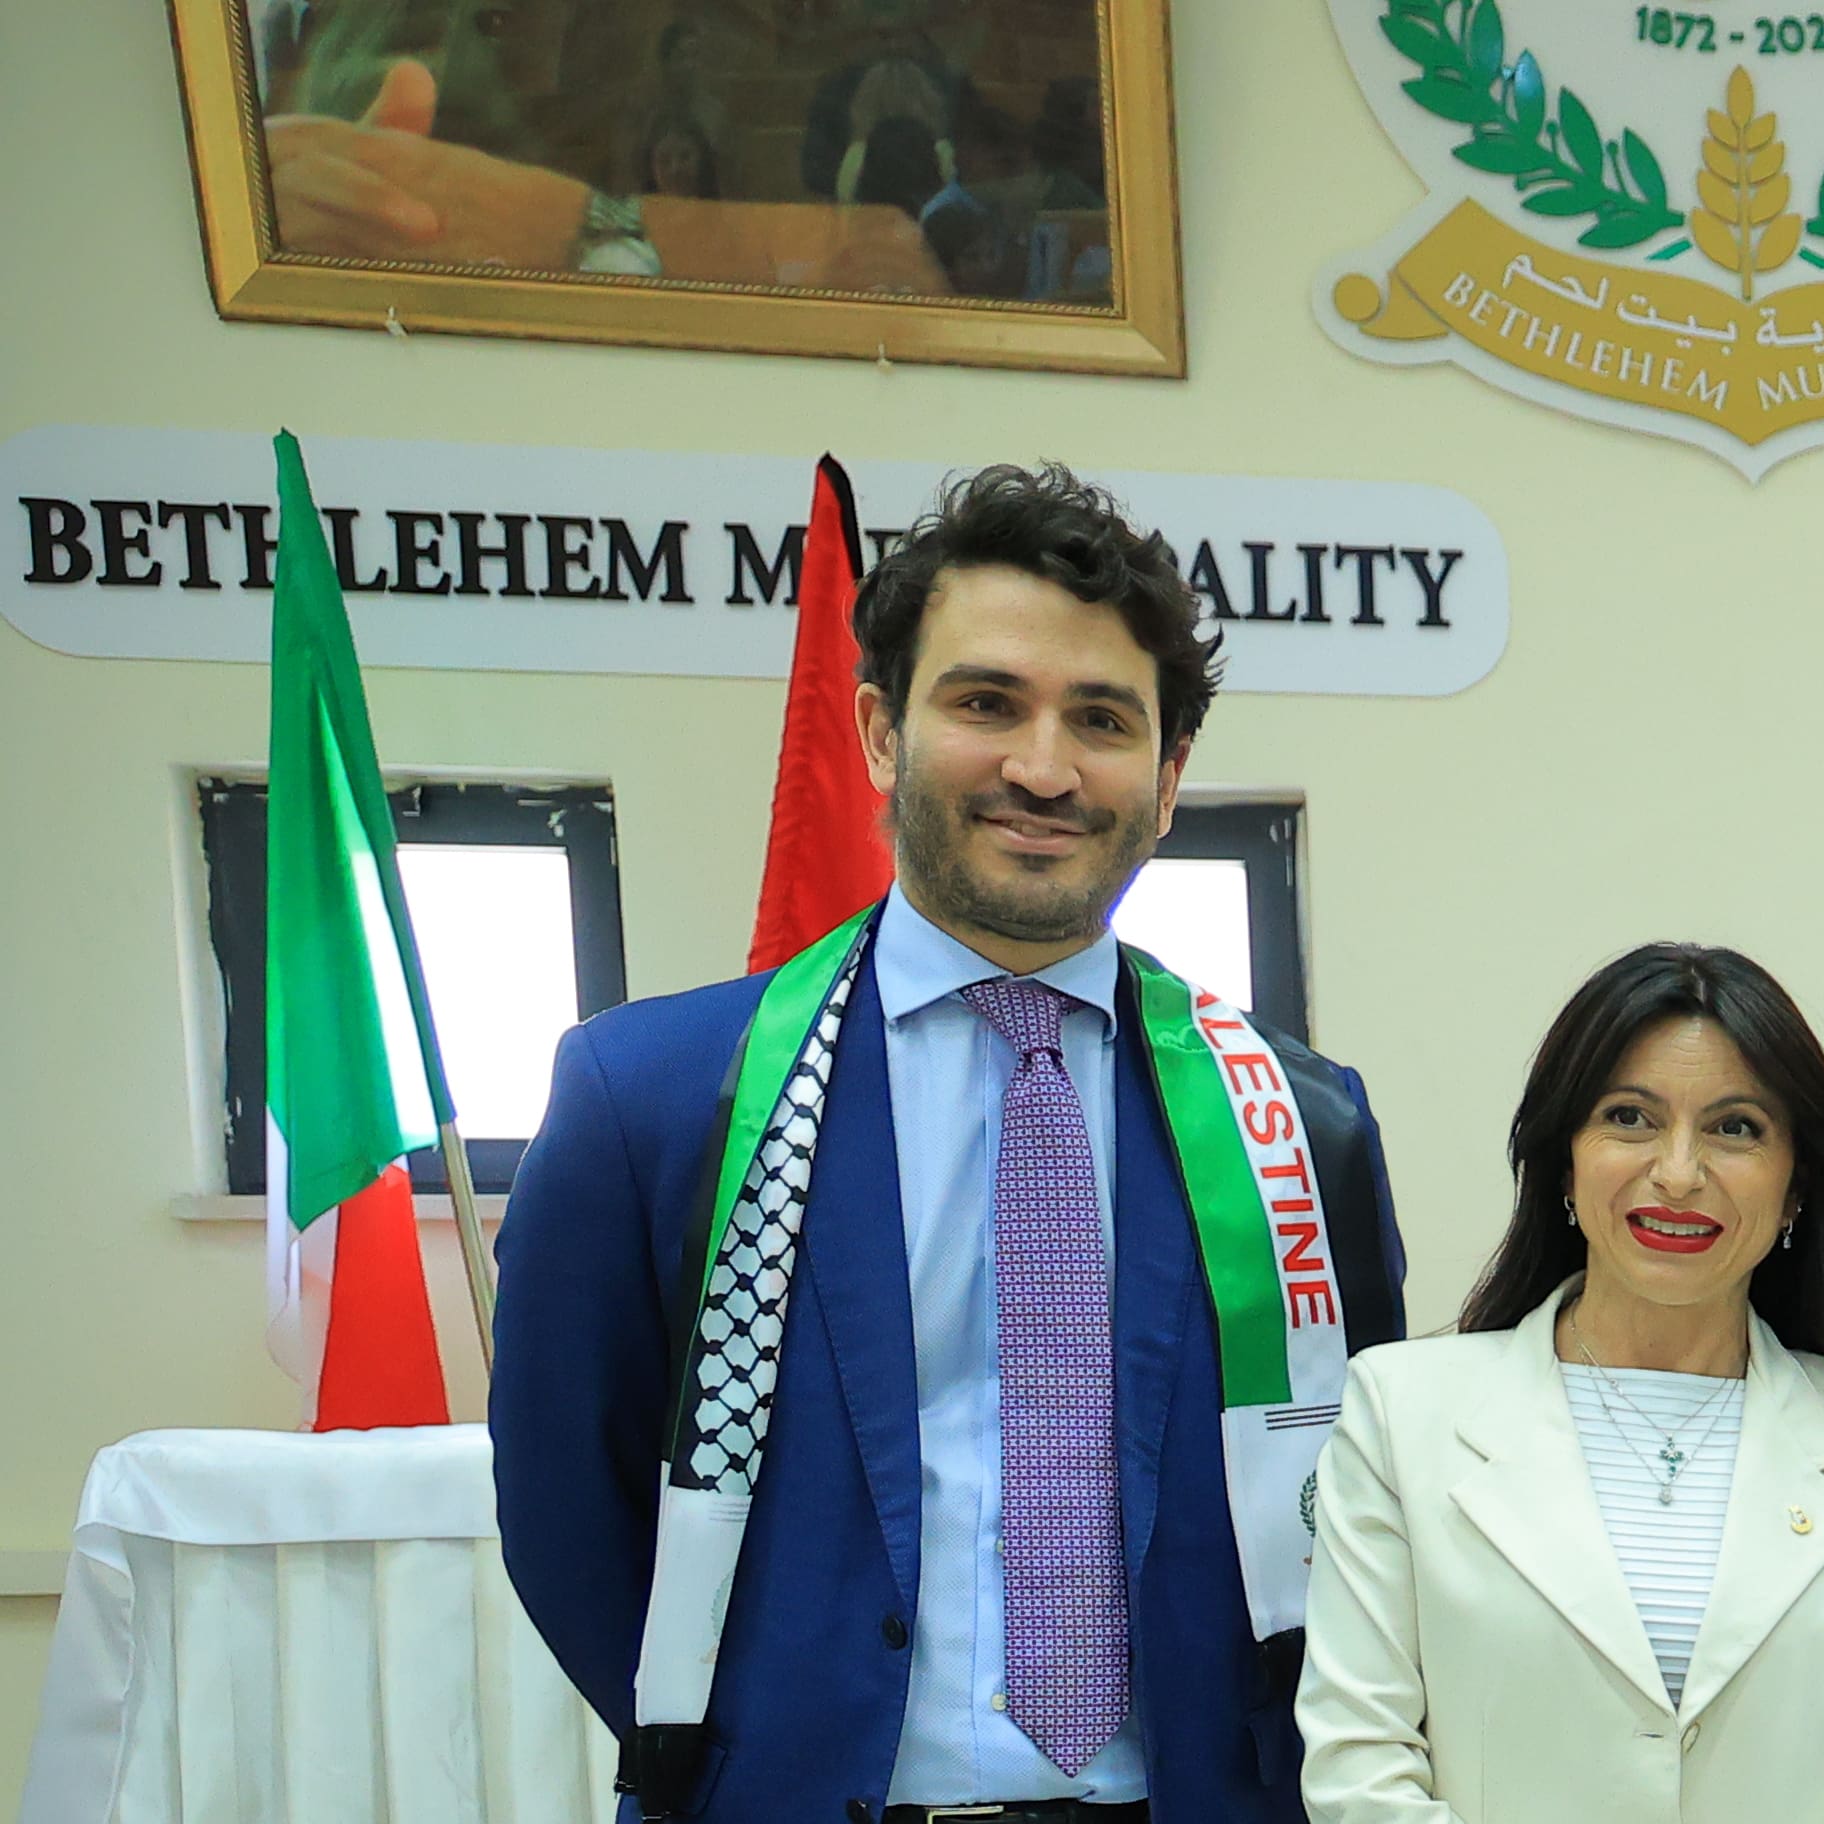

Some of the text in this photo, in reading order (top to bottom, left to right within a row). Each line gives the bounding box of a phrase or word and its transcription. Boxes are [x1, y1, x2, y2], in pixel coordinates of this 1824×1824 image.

[1636, 6, 1716, 51] 1872
[1502, 253, 1610, 310] لحم
[1443, 271, 1729, 411] BETHLEHEM
[1616, 293, 1737, 356] بيت
[723, 522, 1463, 627] MALITY
